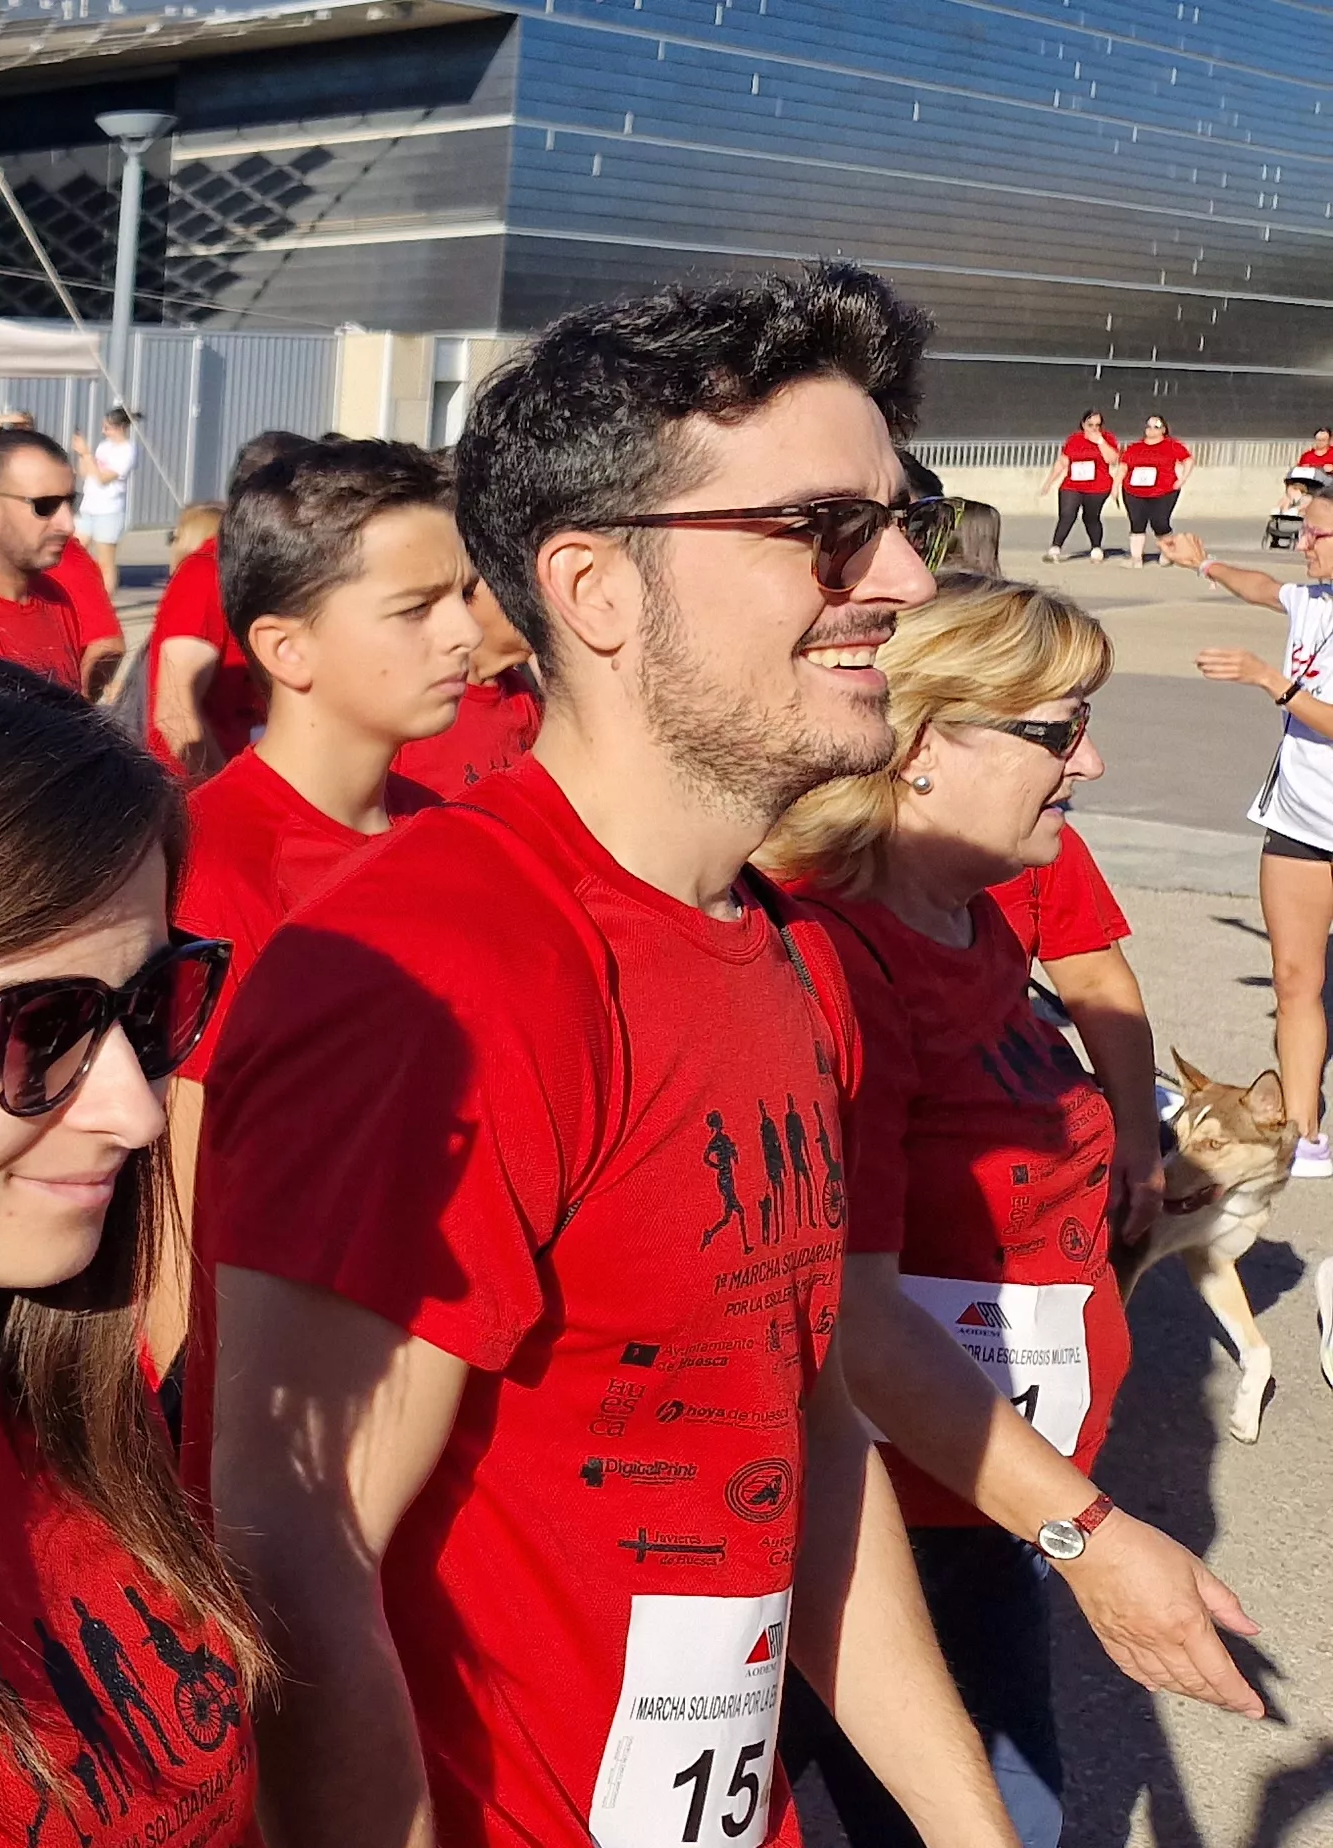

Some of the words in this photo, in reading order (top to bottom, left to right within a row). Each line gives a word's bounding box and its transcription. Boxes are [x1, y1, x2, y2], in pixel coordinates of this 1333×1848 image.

[727, 1257, 780, 1292] MARCHA
[781, 1241, 834, 1275] SOLIDARIA
[724, 1302, 748, 1318] POR
[749, 1296, 762, 1312] LA
[666, 1339, 754, 1359] Ayuntamiento
[983, 1345, 995, 1363] LA
[997, 1346, 1051, 1365] ESCLEROSIS
[656, 1361, 674, 1372] de
[677, 1356, 729, 1369] Huesca
[686, 1405, 725, 1419] hoya
[727, 1406, 748, 1420] de
[636, 1695, 685, 1721] MARCHA
[687, 1693, 741, 1721] SOLIDARIA
[741, 1691, 760, 1716] POR
[672, 1739, 766, 1843] 15
[144, 1770, 225, 1846] SOLIDARIA
